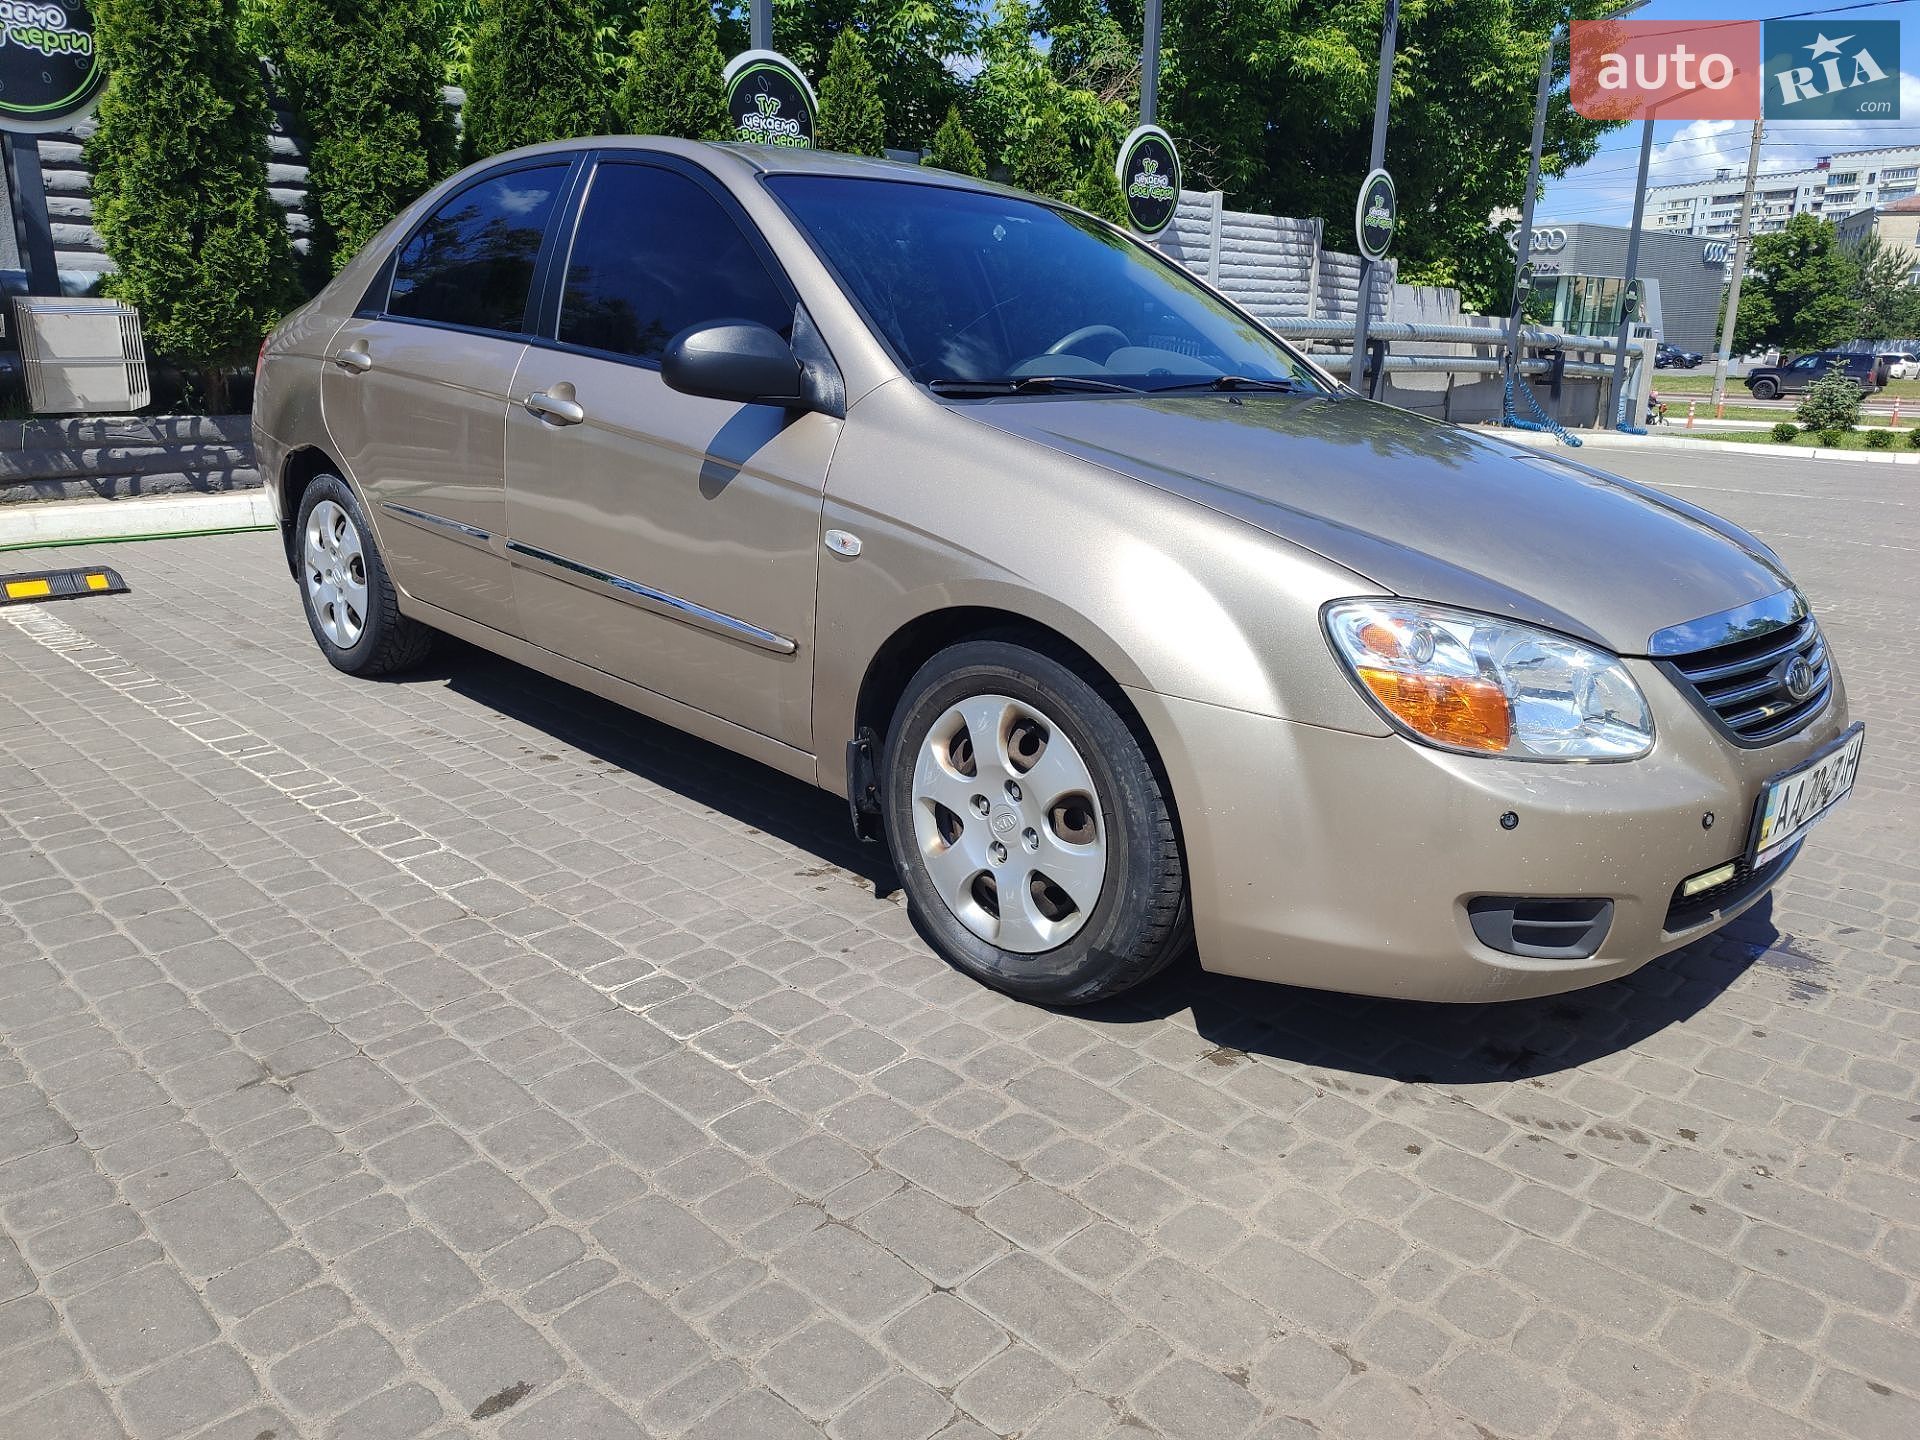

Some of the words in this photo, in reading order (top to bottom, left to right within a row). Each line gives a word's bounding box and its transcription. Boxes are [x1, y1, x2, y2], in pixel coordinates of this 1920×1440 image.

[0, 2, 63, 28] аємо
[11, 27, 88, 52] черги
[744, 115, 798, 134] чекаємо
[1772, 779, 1805, 835] AA
